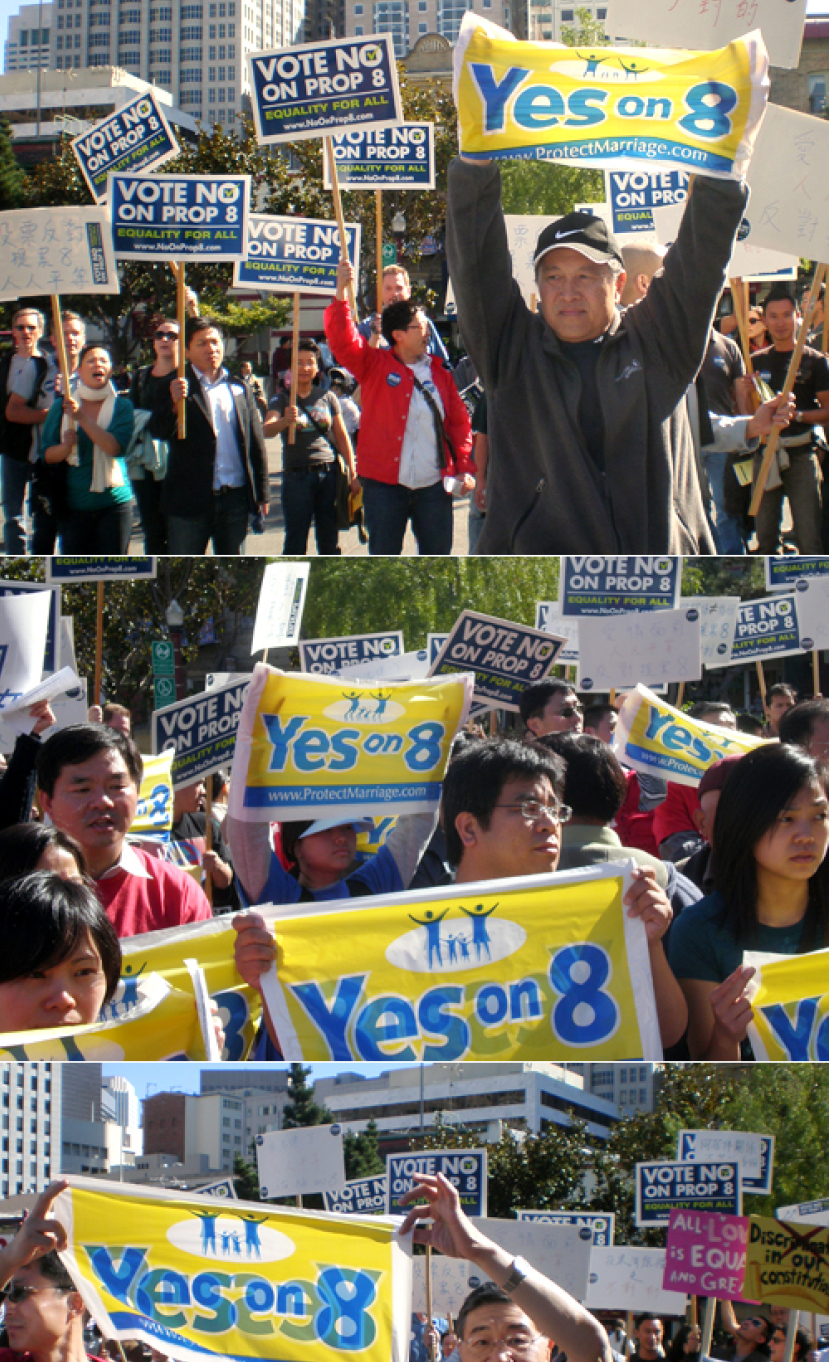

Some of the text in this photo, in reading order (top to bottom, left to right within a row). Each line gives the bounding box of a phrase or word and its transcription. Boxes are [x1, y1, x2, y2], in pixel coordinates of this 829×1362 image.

[256, 43, 383, 82] VOTE NO
[262, 69, 386, 102] ON PROP 8
[265, 95, 389, 120] EQUALITY FOR ALL
[467, 62, 738, 142] Yes on 8
[78, 98, 152, 156] VOTE NO
[283, 112, 373, 130] www.NoOnProp8.com
[87, 151, 111, 171] ON
[110, 124, 146, 156] PROP
[148, 116, 160, 131] 8
[333, 128, 426, 145] VOTE NO
[132, 135, 166, 161] FOR ALL
[334, 147, 426, 159] ON PROP 8
[336, 165, 381, 173] EQUALITY
[613, 172, 671, 190] VOTE
[117, 180, 240, 204] VOTE NO
[616, 188, 687, 207] ON PRO
[118, 203, 238, 223] ON PROP 8
[617, 211, 653, 221] EQUAL
[117, 228, 238, 239] EQUALITY FOR ALL
[249, 221, 307, 244] VOTE
[133, 242, 222, 253] www.NoOnProp8.com
[248, 241, 333, 261] ON PROP
[245, 262, 299, 273] EQUALITY
[303, 266, 325, 275] FOR
[570, 557, 673, 575] VOTE NO
[773, 563, 816, 573] EQUALITY
[569, 575, 671, 591] ON PROP 8
[568, 595, 670, 605] EQUALITY FOR ALL
[760, 600, 792, 618] NO
[739, 616, 795, 636] PROP 8
[306, 638, 396, 661] VOTE NO
[463, 619, 519, 651] VOTE
[516, 635, 554, 661] NO
[757, 637, 776, 645] FOR
[310, 661, 337, 674] ON
[451, 643, 483, 662] ON
[482, 651, 529, 674] PROP
[530, 663, 543, 679] 8
[489, 677, 512, 687] FOR
[160, 696, 218, 737] VOTE
[162, 711, 242, 752] ON PROP
[260, 713, 445, 773] Yes on 8
[171, 736, 236, 771] QUALITY FOR
[269, 786, 426, 801] www.ProtectMarriage.com
[287, 942, 621, 1061] Yes on 8
[391, 1156, 478, 1178] VOTE NO
[642, 1165, 735, 1184] VOTE NO
[328, 1183, 370, 1201] VOTE
[392, 1178, 414, 1193] ON
[466, 1176, 478, 1191] 8
[644, 1182, 734, 1198] ON PROP 8
[332, 1201, 353, 1212] ON
[357, 1195, 385, 1208] PRO
[645, 1200, 734, 1210] EQUALITY FOR ALL
[691, 1245, 746, 1271] EQUA
[765, 1249, 825, 1270] in our
[670, 1270, 696, 1284] AND
[78, 1242, 385, 1353] Yes on 8
